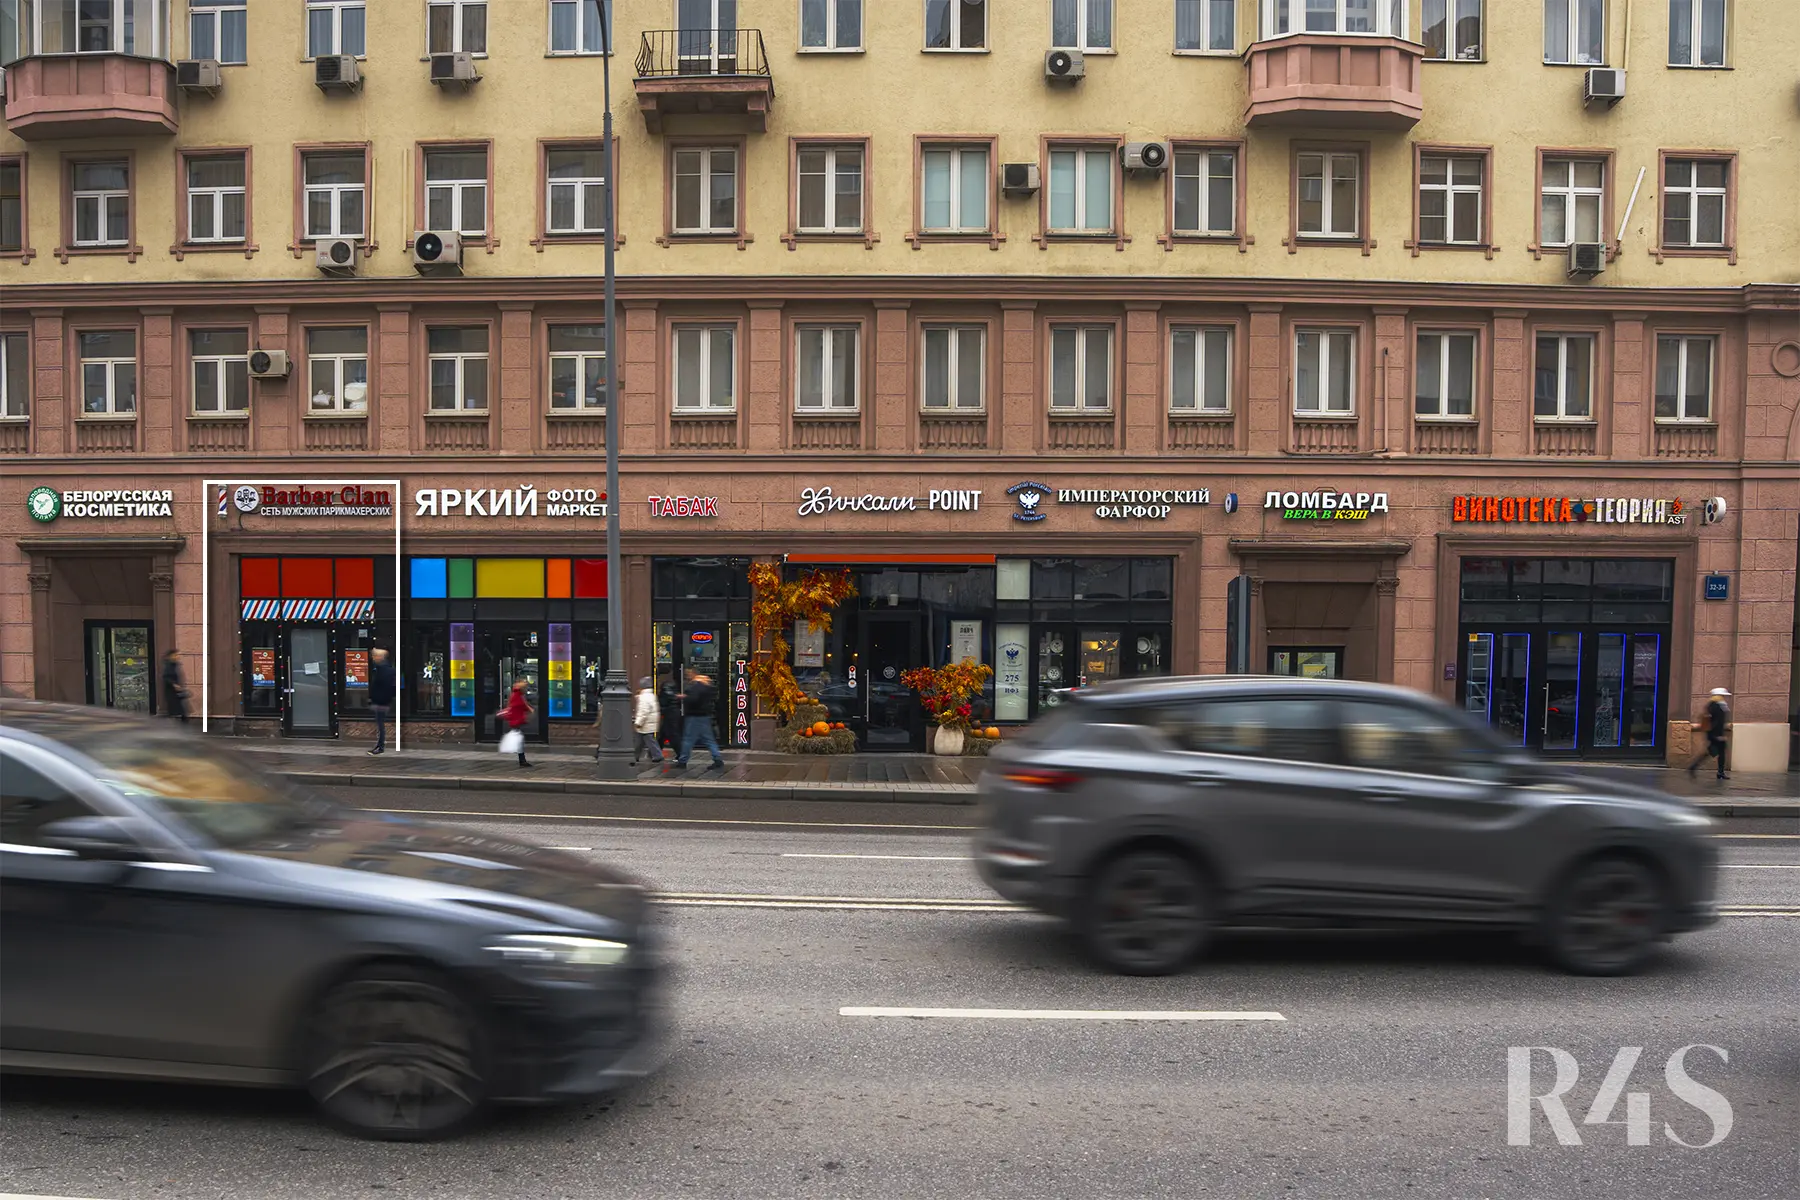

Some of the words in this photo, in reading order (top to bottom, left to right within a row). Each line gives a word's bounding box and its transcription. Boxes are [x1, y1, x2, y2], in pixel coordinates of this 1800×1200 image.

[63, 490, 172, 502] БЕЛОРУССКАЯ
[262, 485, 334, 505] Barber
[340, 485, 391, 505] Clan
[415, 484, 538, 516] ЯРКИЙ
[547, 489, 597, 502] ФОТО
[929, 490, 982, 510] POINT
[1058, 488, 1210, 503] ИМПЕРАТОРСКИЙ
[648, 496, 718, 517] ТАБАК
[1264, 492, 1389, 513] ЛОМБАРД
[1453, 496, 1572, 522] ВИНОТЕКА
[1595, 498, 1666, 523] ТЕОРИЯ
[63, 503, 172, 517] КОСМЕТИКА
[260, 506, 281, 516] СЕТЬ
[282, 506, 318, 516] МУЖСКИХ
[320, 506, 390, 516] ПАРИКМАХЕРСКИХ
[547, 504, 608, 516] МАРКЕТ
[1095, 505, 1171, 518] ФАРФОР
[1283, 510, 1318, 519] ВЕРА
[1321, 510, 1331, 519] В
[1334, 510, 1369, 520] КЭШ
[1667, 516, 1687, 525] AST
[1004, 674, 1020, 682] 275
[735, 660, 748, 744] ТАБАК
